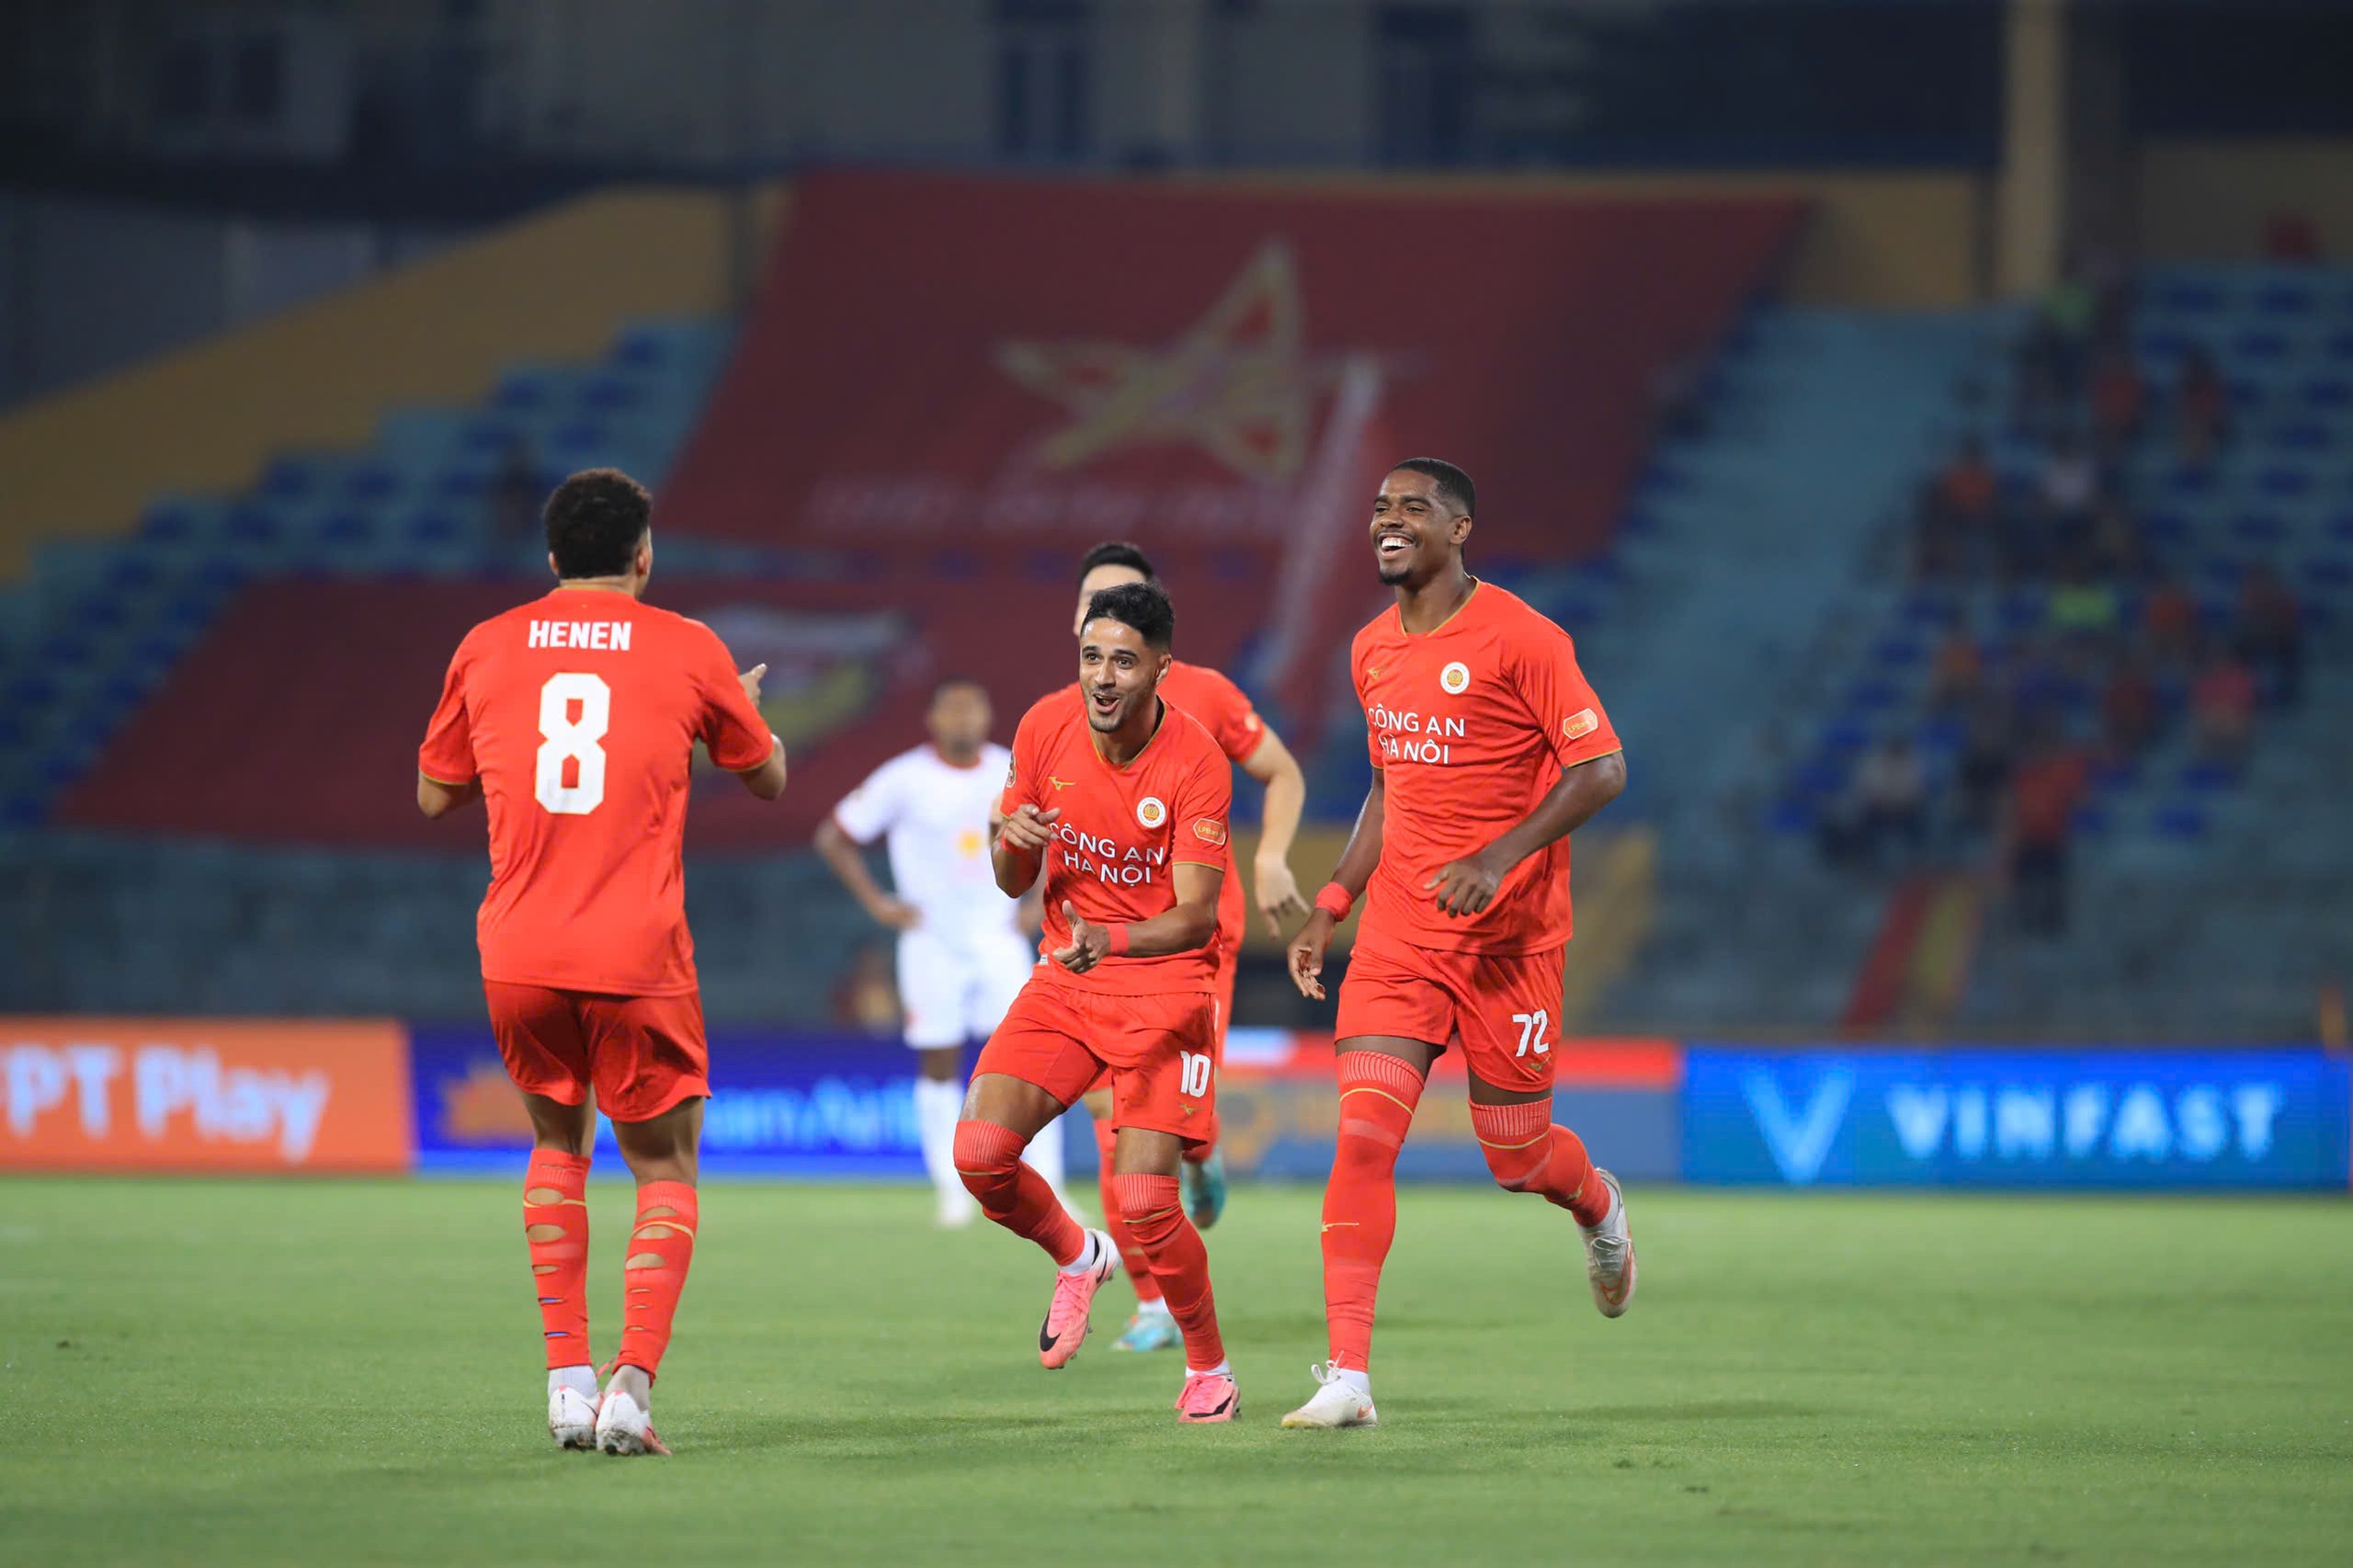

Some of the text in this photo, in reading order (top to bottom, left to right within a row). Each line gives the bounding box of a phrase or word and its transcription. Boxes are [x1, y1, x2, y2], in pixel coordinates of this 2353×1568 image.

[528, 619, 632, 651] HENEN
[534, 672, 610, 815] 8
[1426, 716, 1465, 737] AN
[1049, 822, 1164, 866] CÔNG AN
[1100, 863, 1151, 887] NỘI
[1512, 1008, 1550, 1057] 72
[1179, 1050, 1211, 1098] 10
[0, 1042, 332, 1164] PT Play
[1884, 1080, 2279, 1164] VINFAST
